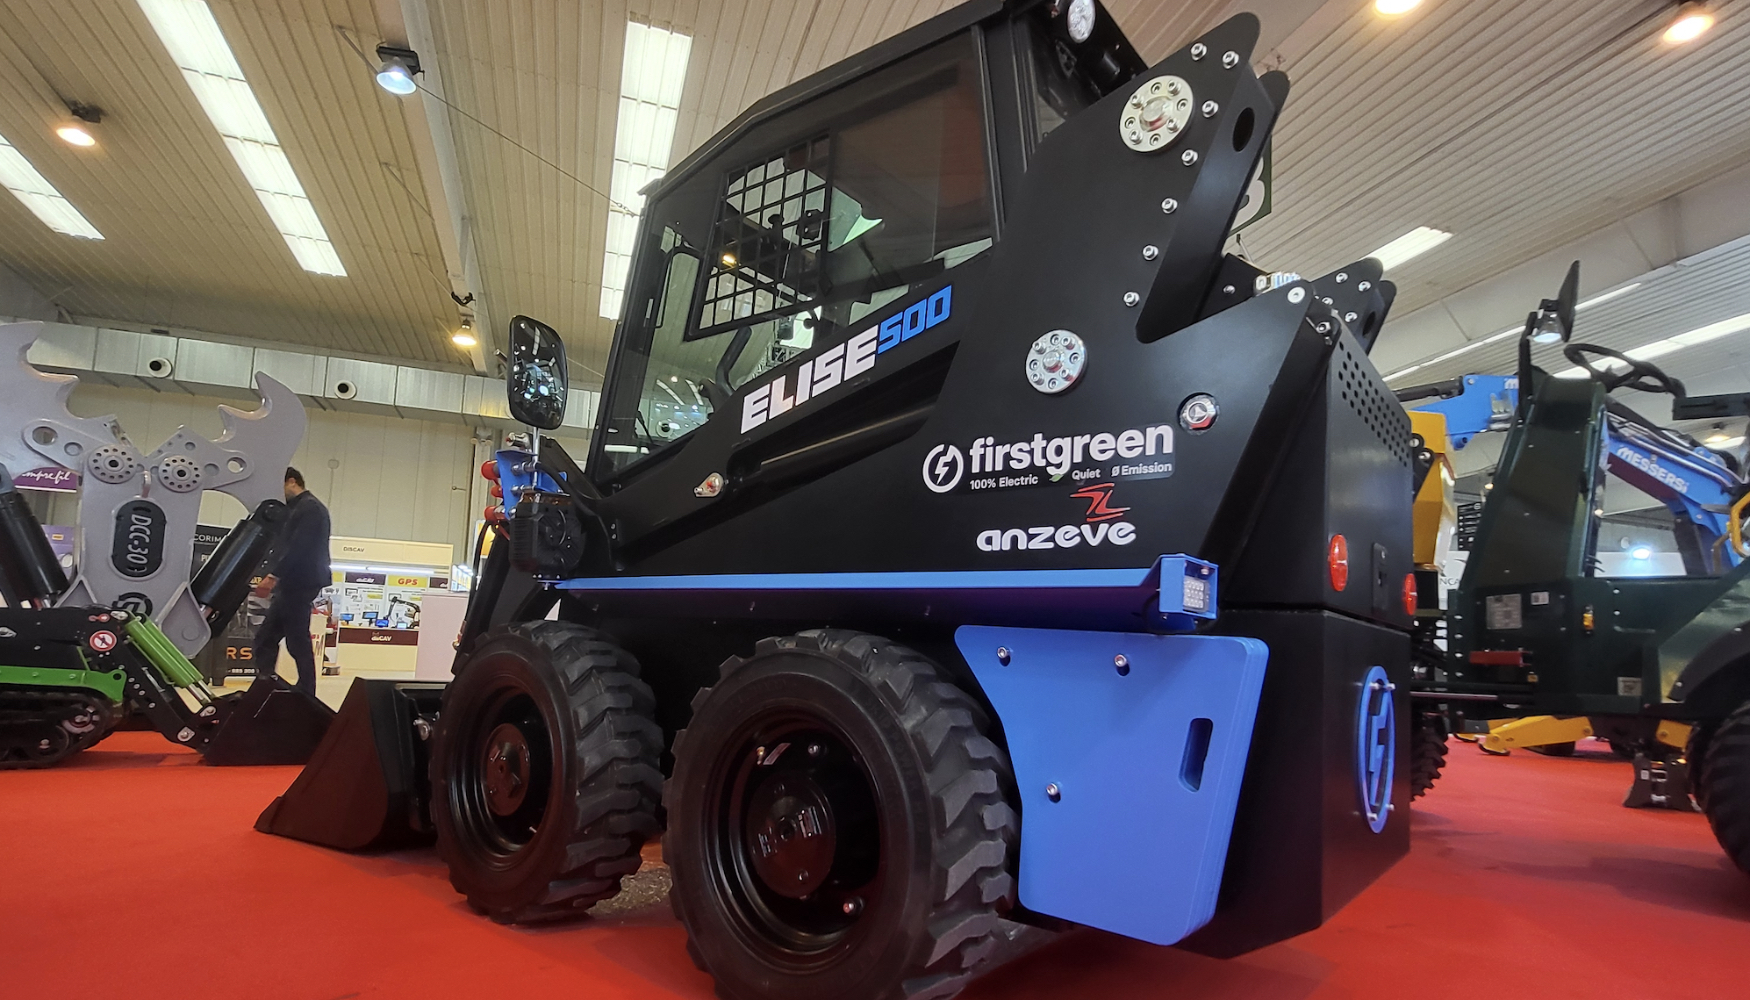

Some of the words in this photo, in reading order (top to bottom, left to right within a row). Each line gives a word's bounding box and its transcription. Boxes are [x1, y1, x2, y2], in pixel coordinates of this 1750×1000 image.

[969, 424, 1174, 475] firstgreen
[969, 478, 996, 490] 100%
[999, 473, 1039, 487] Electric
[1072, 469, 1101, 481] Quiet
[1121, 461, 1172, 476] Emission
[976, 521, 1137, 552] anzeve
[397, 577, 418, 586] GPS
